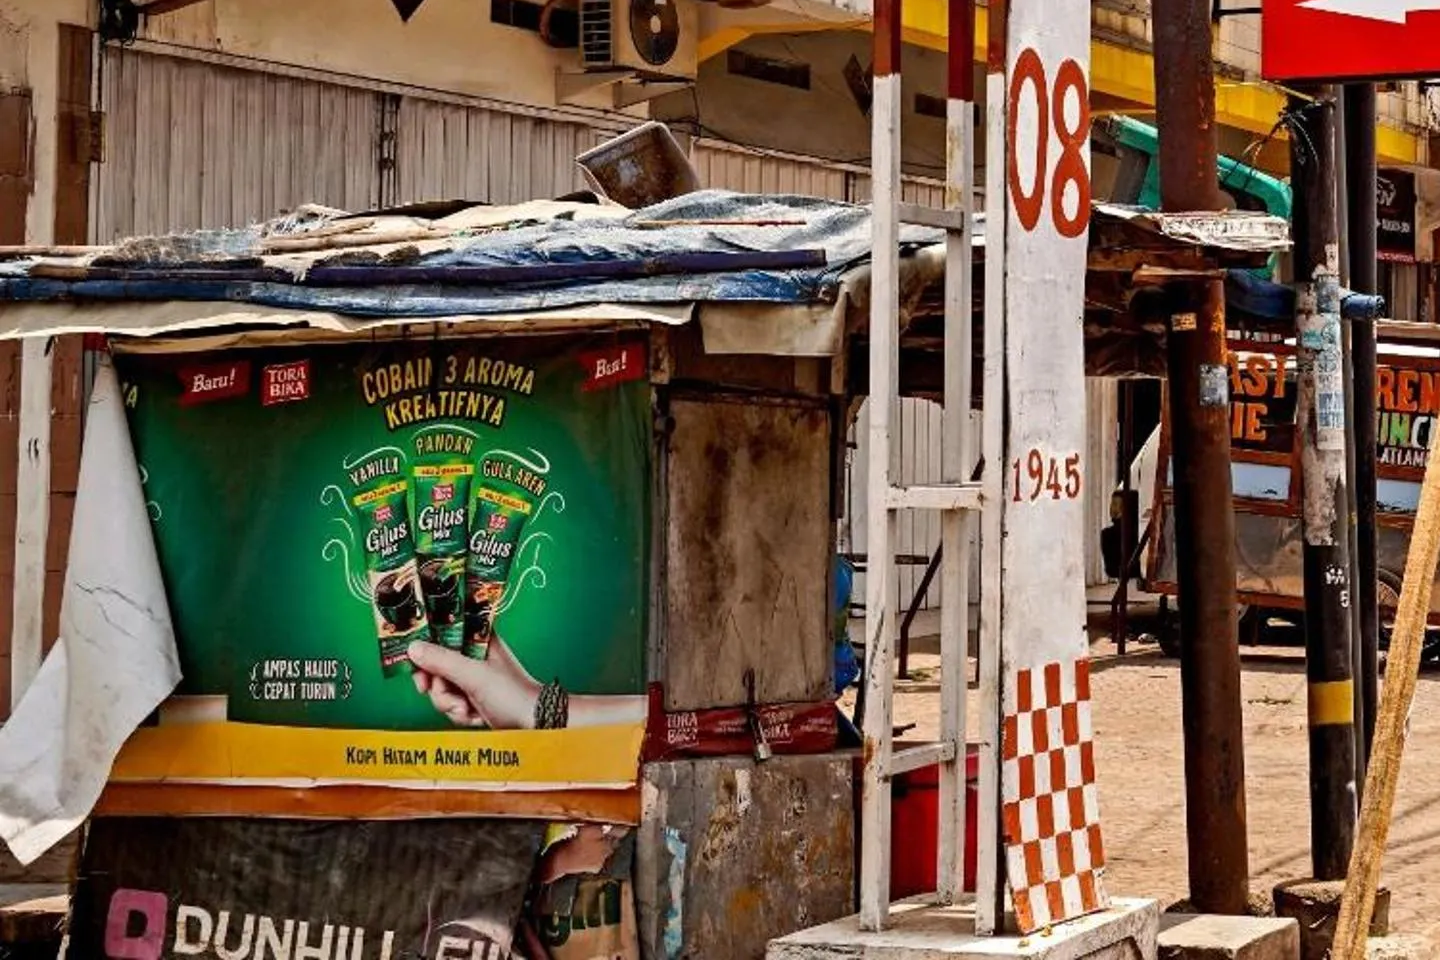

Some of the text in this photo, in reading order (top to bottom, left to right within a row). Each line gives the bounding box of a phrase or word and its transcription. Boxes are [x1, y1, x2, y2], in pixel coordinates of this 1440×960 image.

[1009, 47, 1090, 238] 08
[191, 368, 235, 392] Baru!
[267, 366, 306, 383] TORA
[445, 355, 458, 384] 3
[464, 357, 535, 394] AROMA
[270, 381, 305, 397] BIKA
[385, 390, 505, 429] KREATIFNYA
[350, 456, 399, 486] VANILLA
[482, 460, 512, 480] GULA
[1013, 448, 1082, 502] 1945
[263, 659, 338, 678] AMPAS HALUS
[263, 682, 336, 700] CEPAT TURUN
